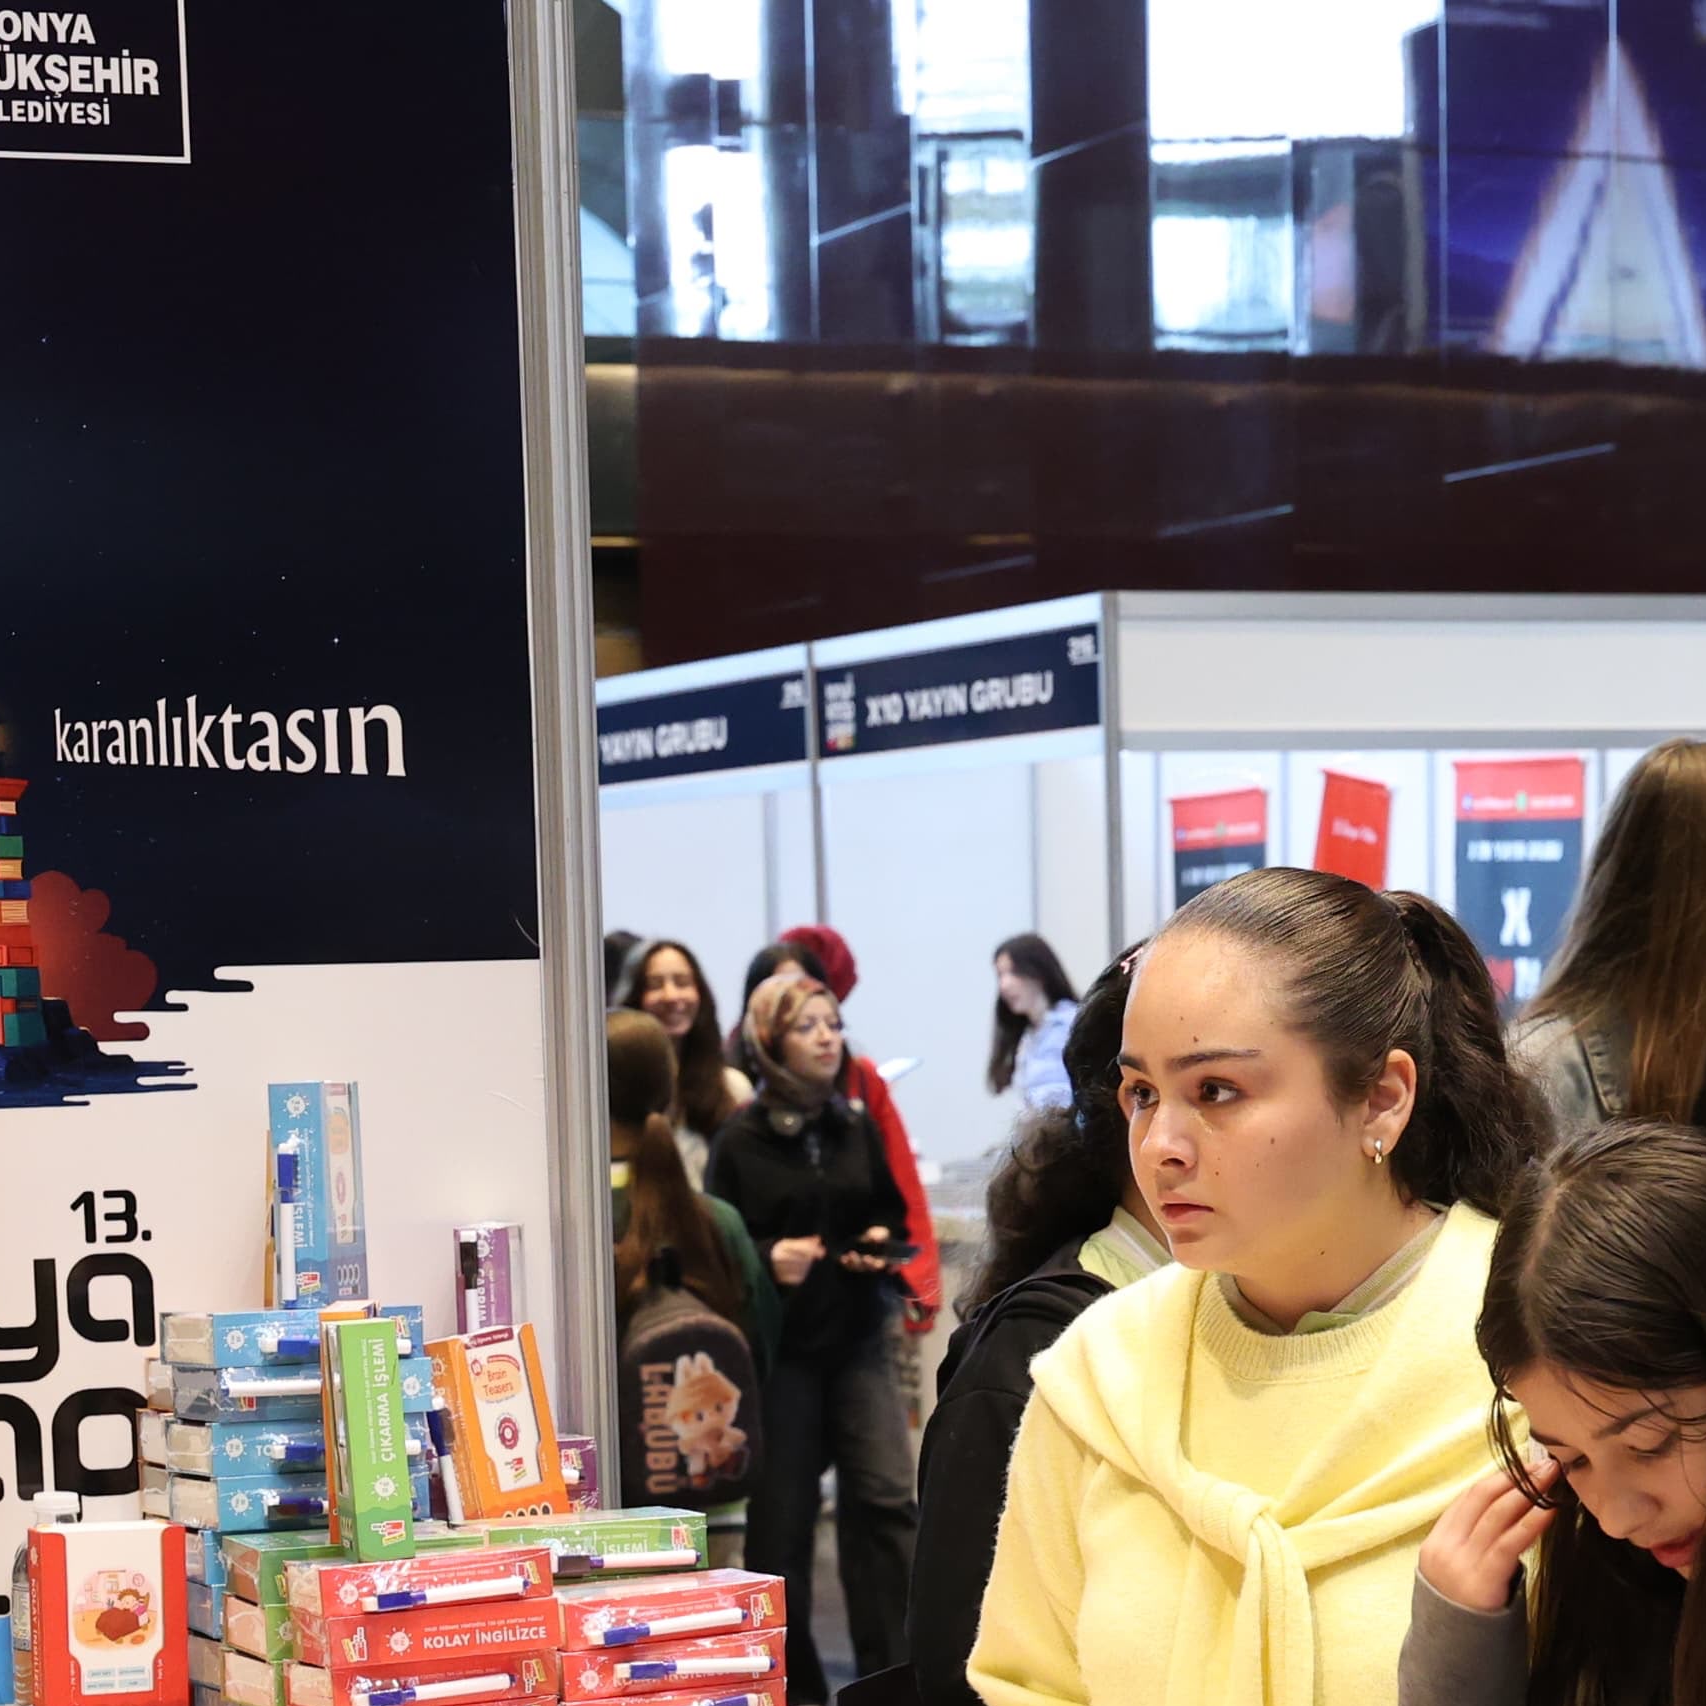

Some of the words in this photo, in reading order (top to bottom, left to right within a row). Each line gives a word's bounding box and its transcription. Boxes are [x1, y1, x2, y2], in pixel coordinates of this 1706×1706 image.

[972, 671, 1054, 713] GRUBU
[55, 694, 407, 778] karanlıktasın
[655, 716, 728, 758] GRUBU
[70, 1189, 153, 1243] 13.
[369, 1338, 390, 1387] İŞLEMİ
[376, 1392, 397, 1463] ÇIKARMA
[423, 1633, 471, 1649] KOLAY
[475, 1624, 547, 1645] İNGİLİZCE
